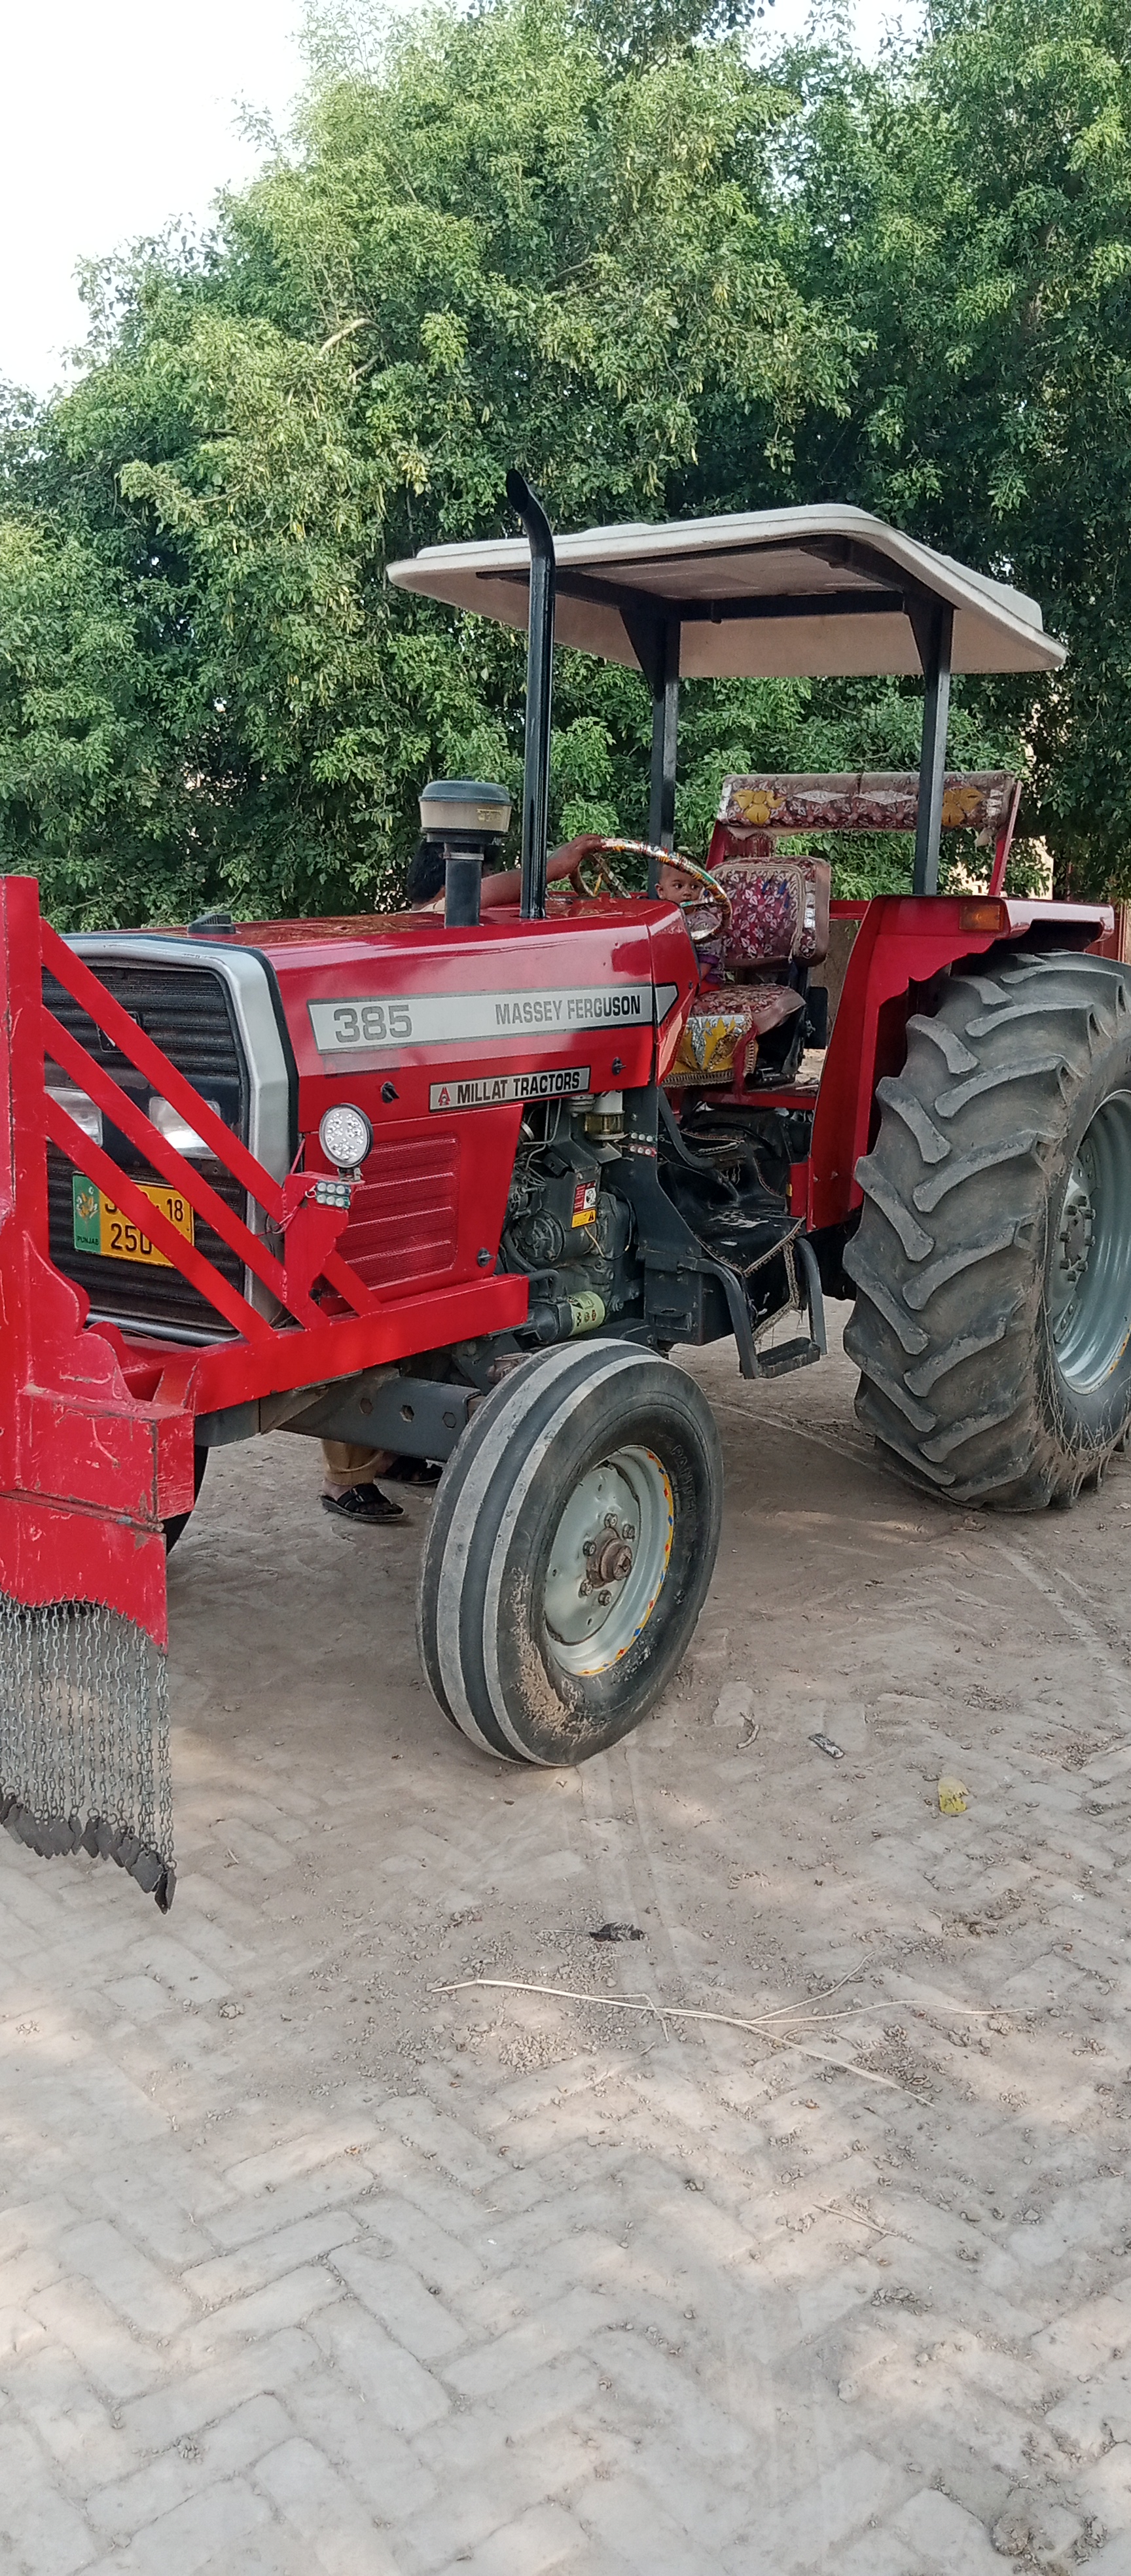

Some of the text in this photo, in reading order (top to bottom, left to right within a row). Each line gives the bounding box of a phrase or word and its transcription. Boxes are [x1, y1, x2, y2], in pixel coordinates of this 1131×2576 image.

[333, 995, 641, 1043] 385 MASSEY FERGUSON
[458, 1071, 581, 1104] MILLAT TRACTORS
[77, 1235, 99, 1245] PUNJAB
